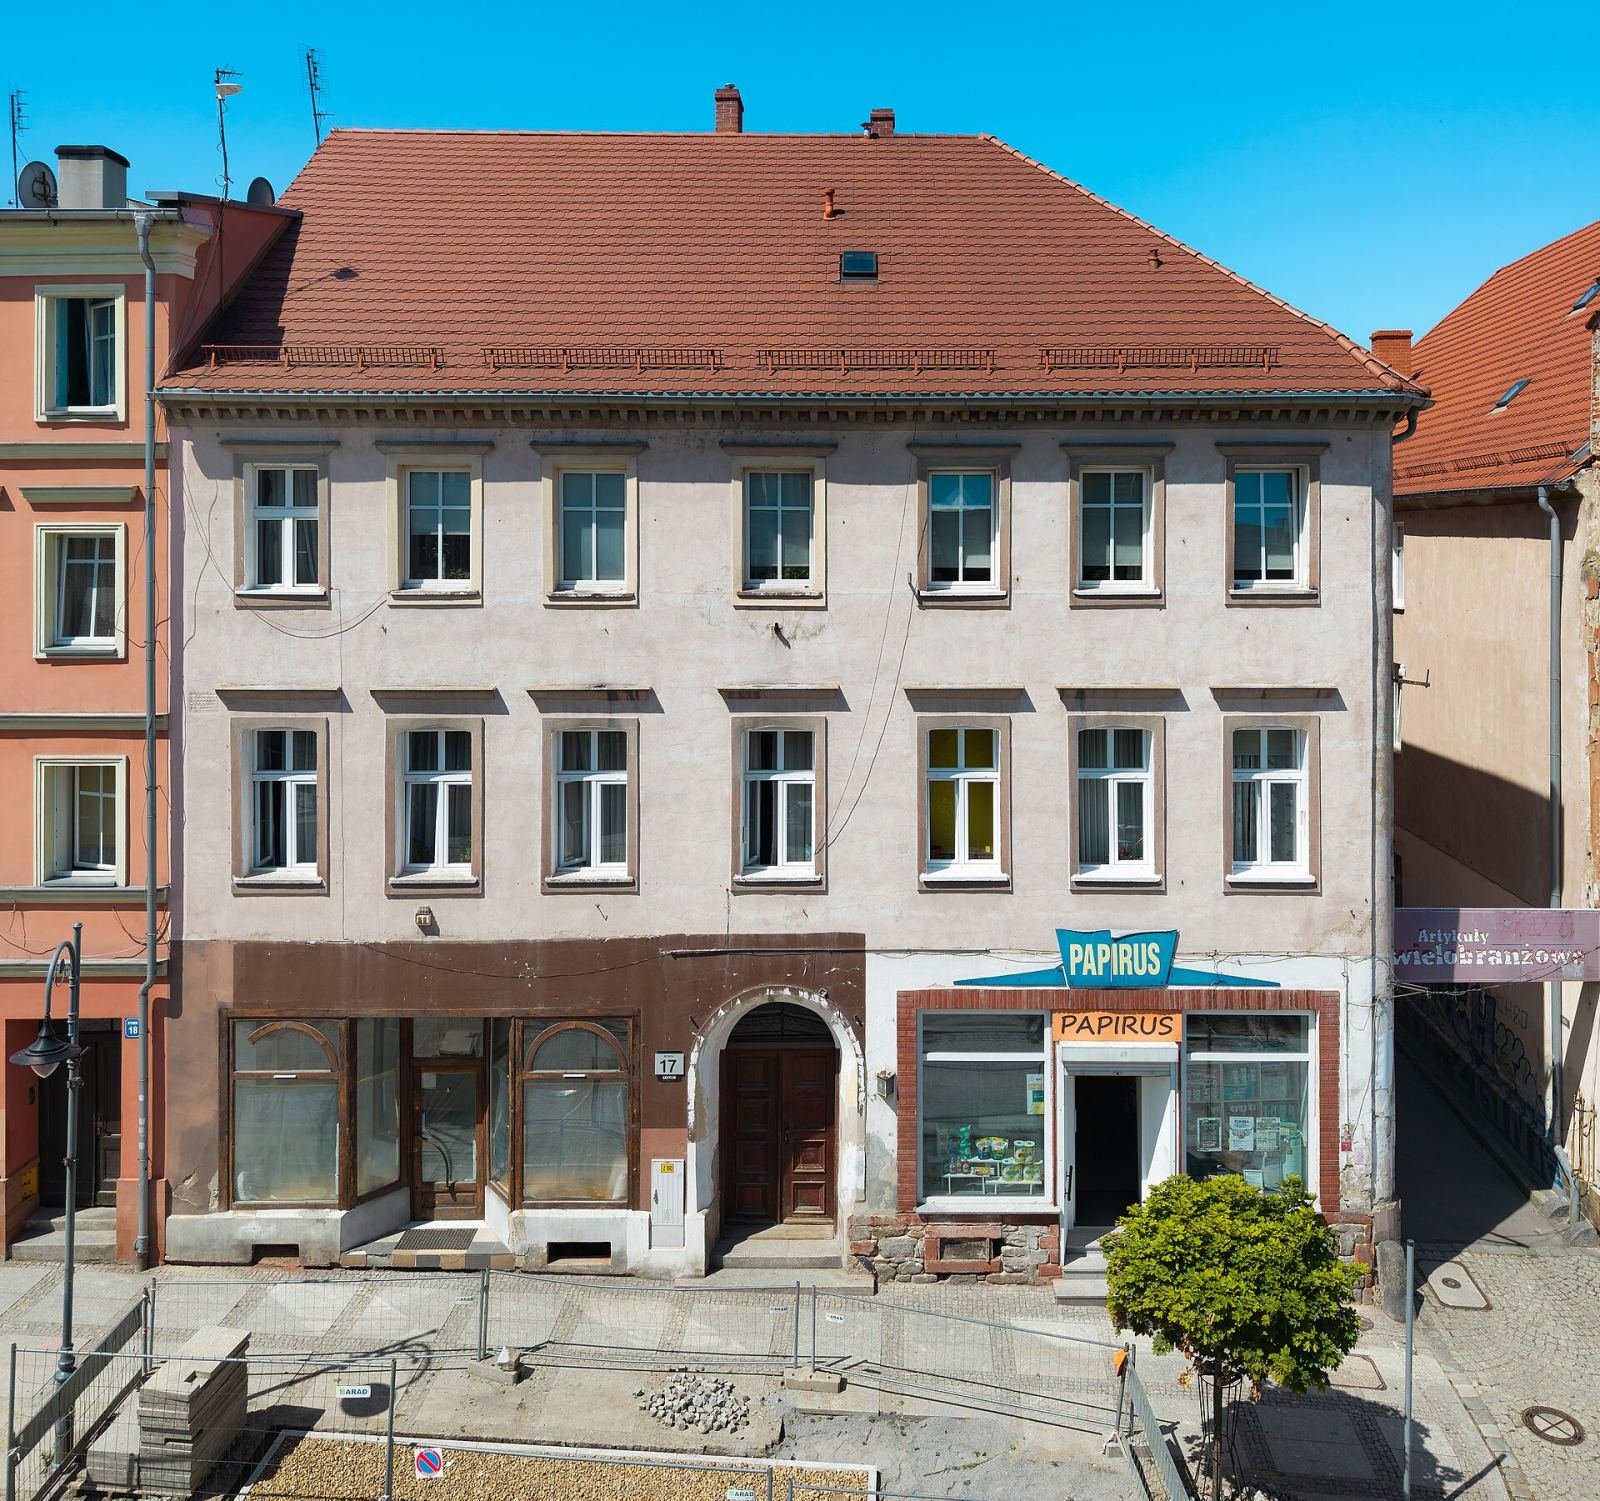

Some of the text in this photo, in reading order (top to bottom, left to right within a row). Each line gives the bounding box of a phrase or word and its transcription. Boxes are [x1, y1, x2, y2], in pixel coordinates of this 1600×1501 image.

[1418, 928, 1490, 943] Artykuły
[1069, 942, 1161, 976] PAPIRUS
[128, 1025, 138, 1035] 18
[1061, 1015, 1174, 1036] PAPIRUS
[660, 1059, 677, 1073] 17
